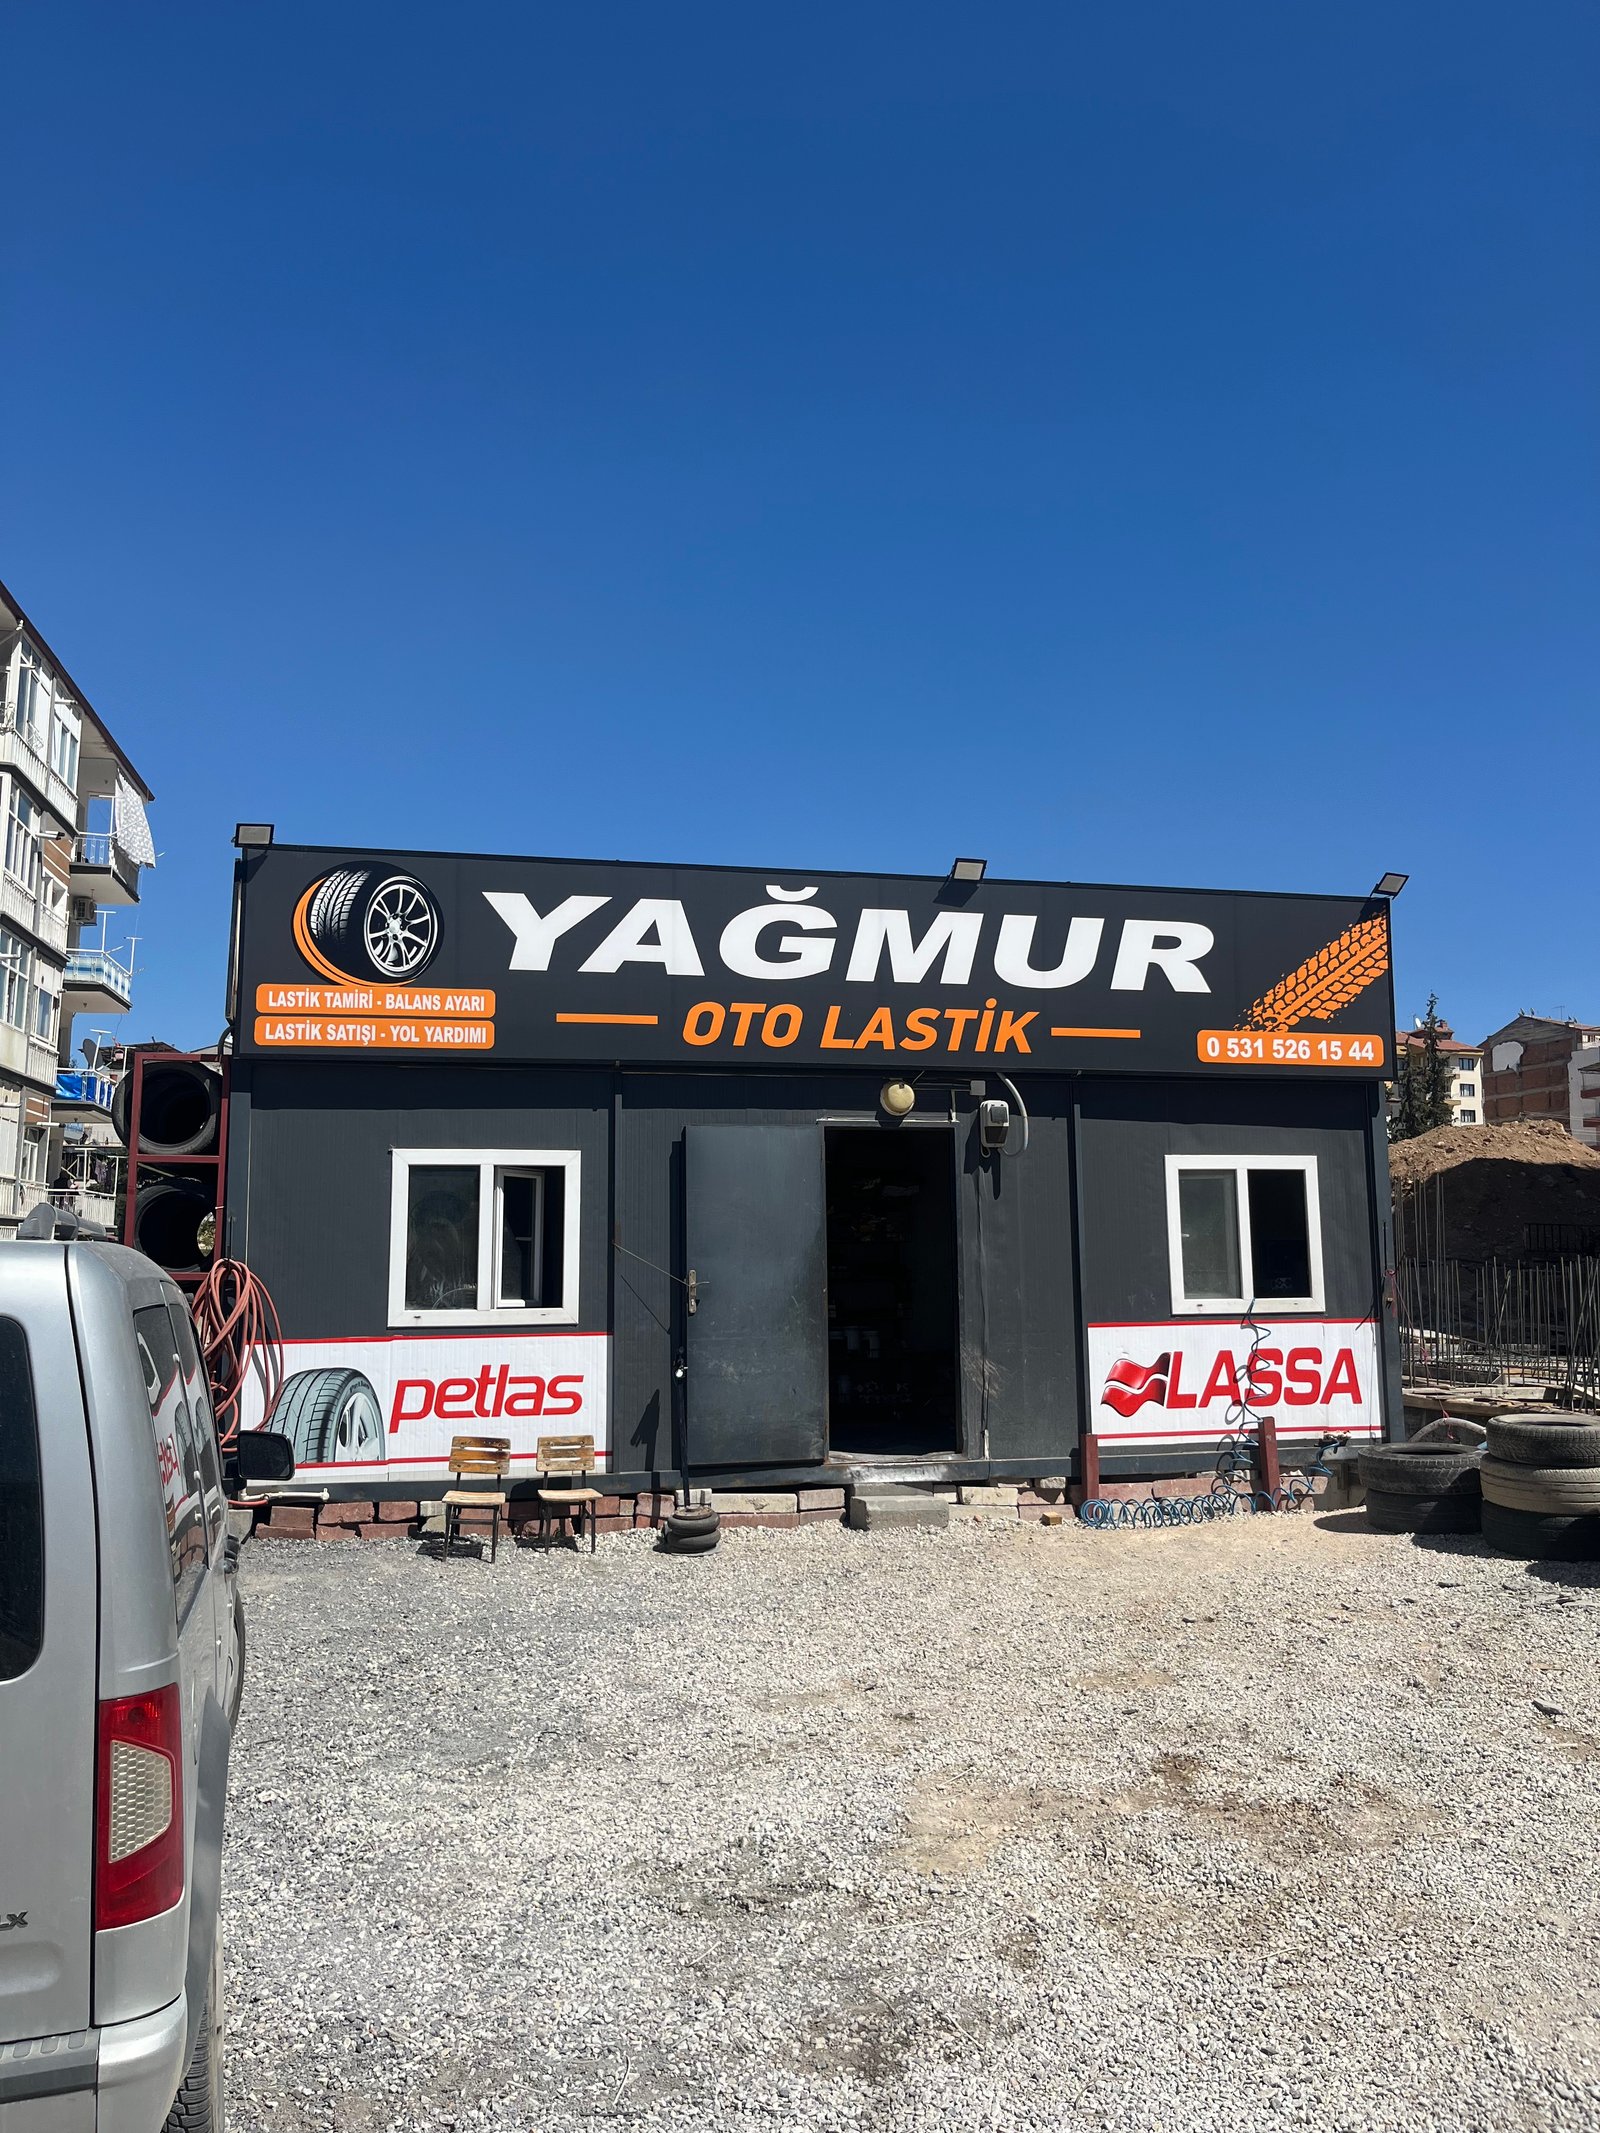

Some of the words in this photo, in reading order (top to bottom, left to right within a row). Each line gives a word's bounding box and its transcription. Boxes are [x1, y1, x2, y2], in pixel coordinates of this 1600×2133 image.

[481, 884, 1215, 994] YAĞMUR
[268, 987, 321, 1008] LASTİK
[324, 989, 373, 1009] TAMİRİ
[385, 993, 441, 1011] BALANS
[444, 995, 485, 1012] AYARI
[682, 1001, 804, 1048] OTO
[820, 998, 1038, 1054] LASTİK
[265, 1020, 322, 1041] LASTİK
[326, 1023, 376, 1046] SATIŞI
[389, 1025, 420, 1043] YOL
[424, 1026, 487, 1044] YARDIMI
[1206, 1036, 1220, 1057] 0
[1226, 1037, 1264, 1059] 531
[1272, 1038, 1311, 1060] 526
[1317, 1040, 1343, 1061] 15
[1348, 1041, 1375, 1061] 44
[388, 1364, 584, 1434] petlas
[1166, 1347, 1363, 1409] LASSA
